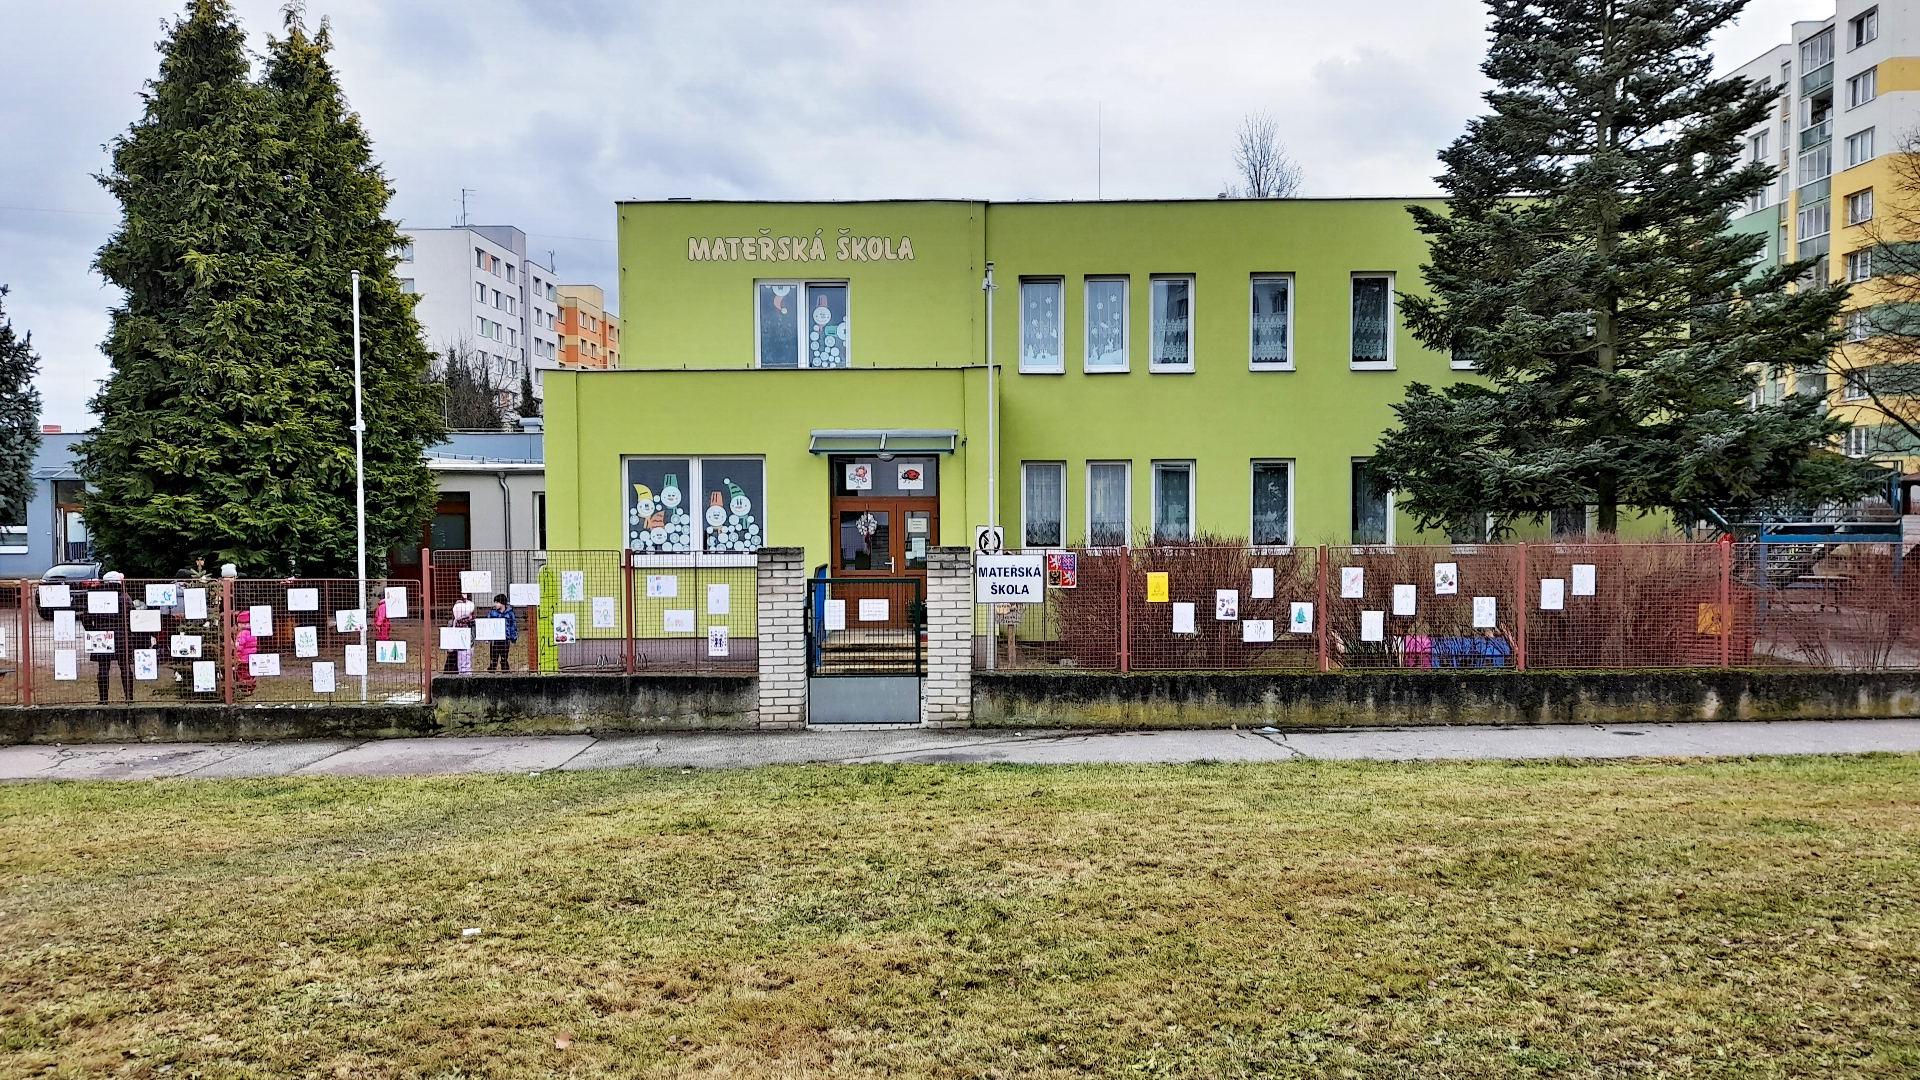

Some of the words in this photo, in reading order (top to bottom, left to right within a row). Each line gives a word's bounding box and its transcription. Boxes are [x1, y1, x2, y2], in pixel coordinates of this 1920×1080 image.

[687, 228, 827, 263] MATEŘSKÁ
[836, 227, 915, 263] ŠKOLA
[978, 564, 1042, 578] MATEŘSKÁ
[990, 583, 1030, 595] ŠKOLA
